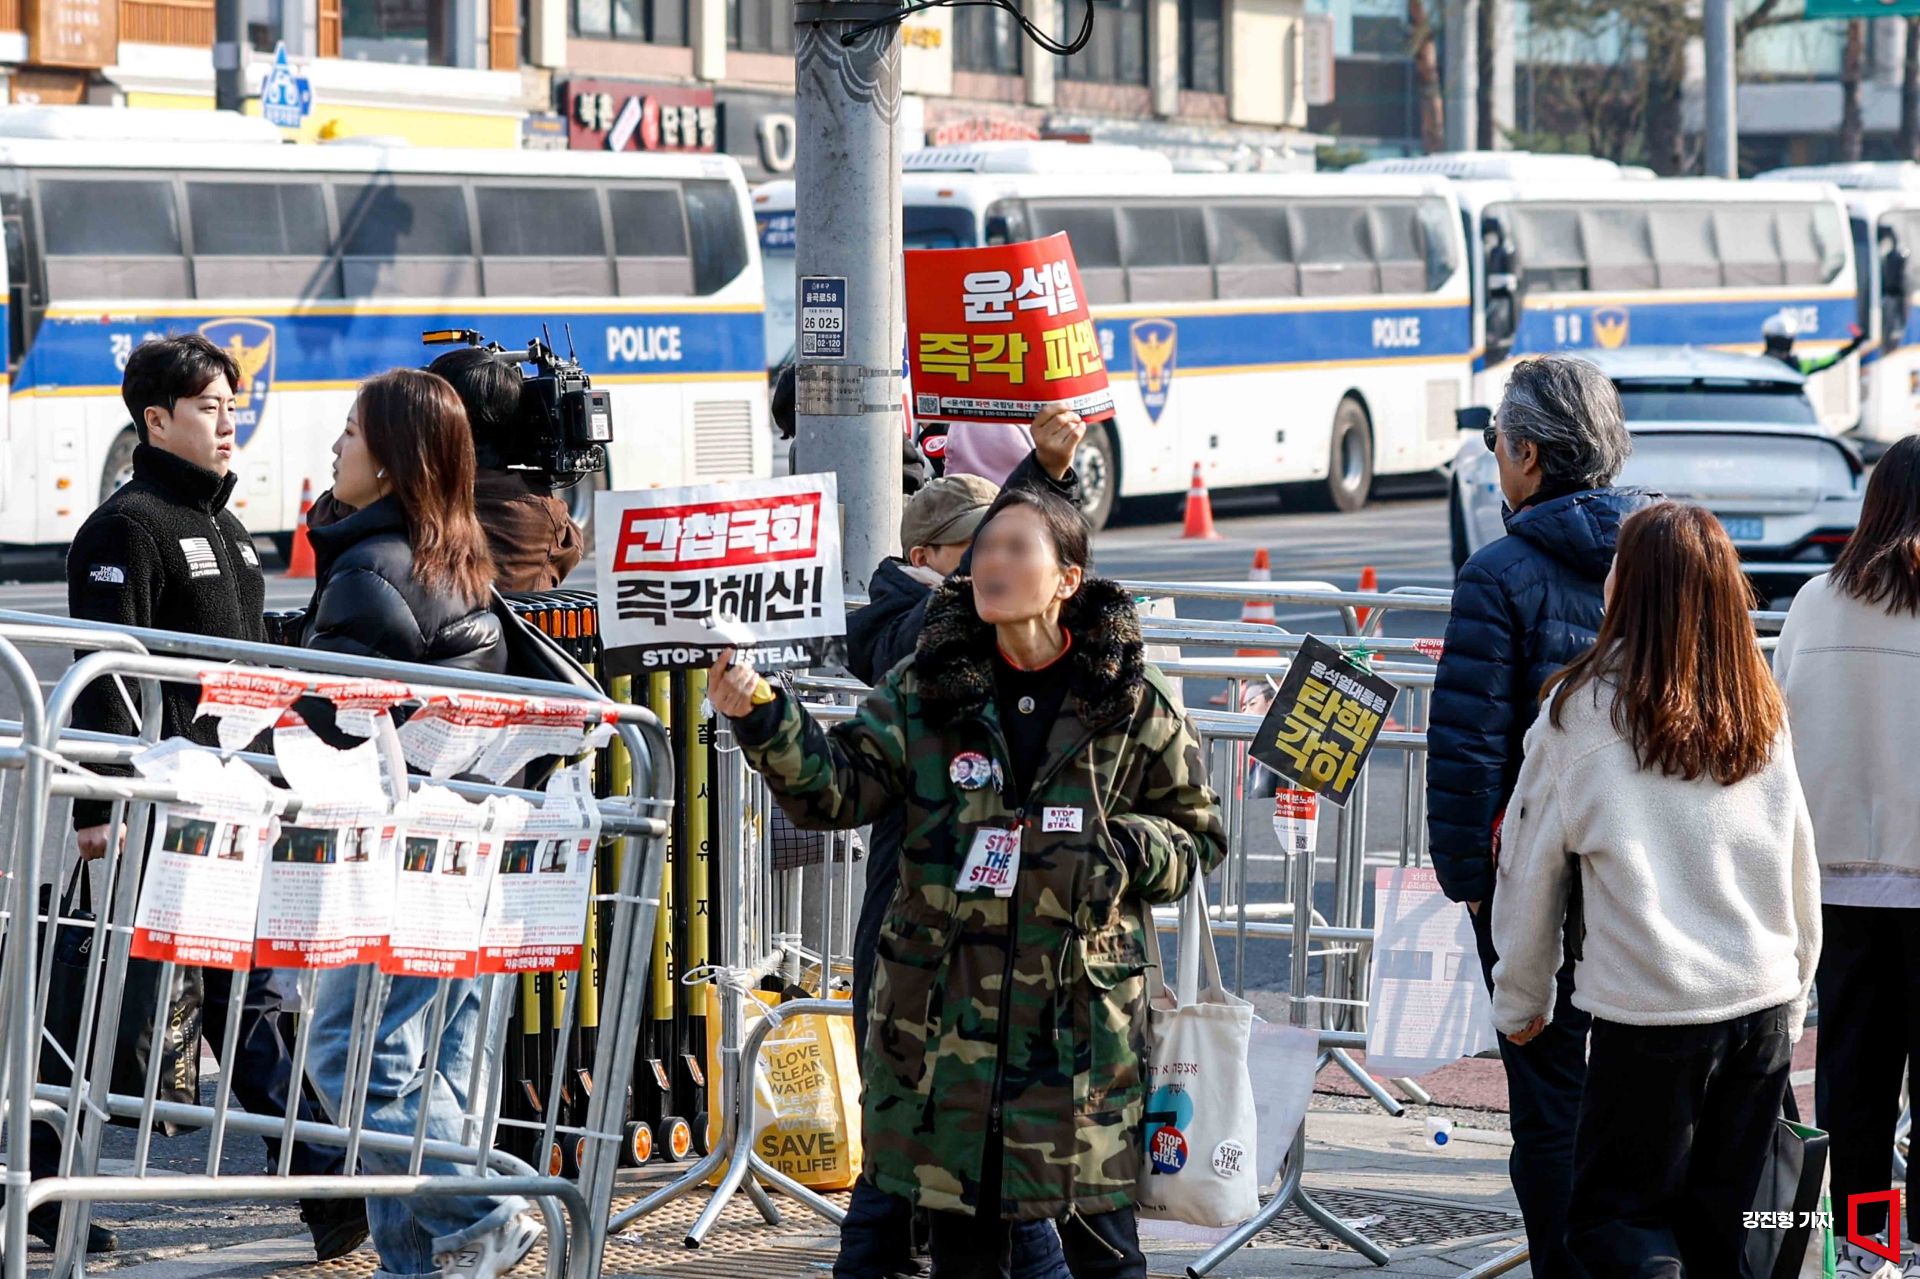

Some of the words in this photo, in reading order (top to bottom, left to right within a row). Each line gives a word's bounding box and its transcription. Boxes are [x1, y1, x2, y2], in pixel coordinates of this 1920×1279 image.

[963, 259, 1079, 322] 윤석열
[805, 317, 815, 329] 26
[818, 317, 840, 329] 025
[1372, 317, 1420, 347] POLICE
[606, 326, 682, 361] POLICE
[817, 340, 840, 348] 02-120
[919, 332, 1029, 384] 즉각
[1042, 318, 1104, 381] 파면
[624, 504, 814, 564] 간첩국회
[643, 648, 704, 667] STOP
[708, 647, 747, 665] TE
[747, 645, 811, 664] STEAL
[1292, 677, 1380, 758] 탄핵
[1275, 716, 1358, 793] 각하
[1051, 809, 1075, 817] STOP
[985, 835, 1018, 852] STOP
[985, 852, 1011, 869] THE
[969, 866, 1009, 885] STEAL
[171, 1005, 186, 1089] PARADOX
[777, 1045, 820, 1069] LOVE
[771, 1060, 823, 1082] CLEAN
[769, 1073, 825, 1095] WATER
[762, 1132, 836, 1158] SAVE
[1157, 1131, 1182, 1146] STOP
[1152, 1152, 1181, 1168] STEAL
[1159, 1143, 1177, 1158] THE
[1220, 1146, 1243, 1157] STOP
[1222, 1154, 1238, 1164] THE
[797, 1157, 836, 1173] LIFE!
[1214, 1159, 1241, 1172] STEAL
